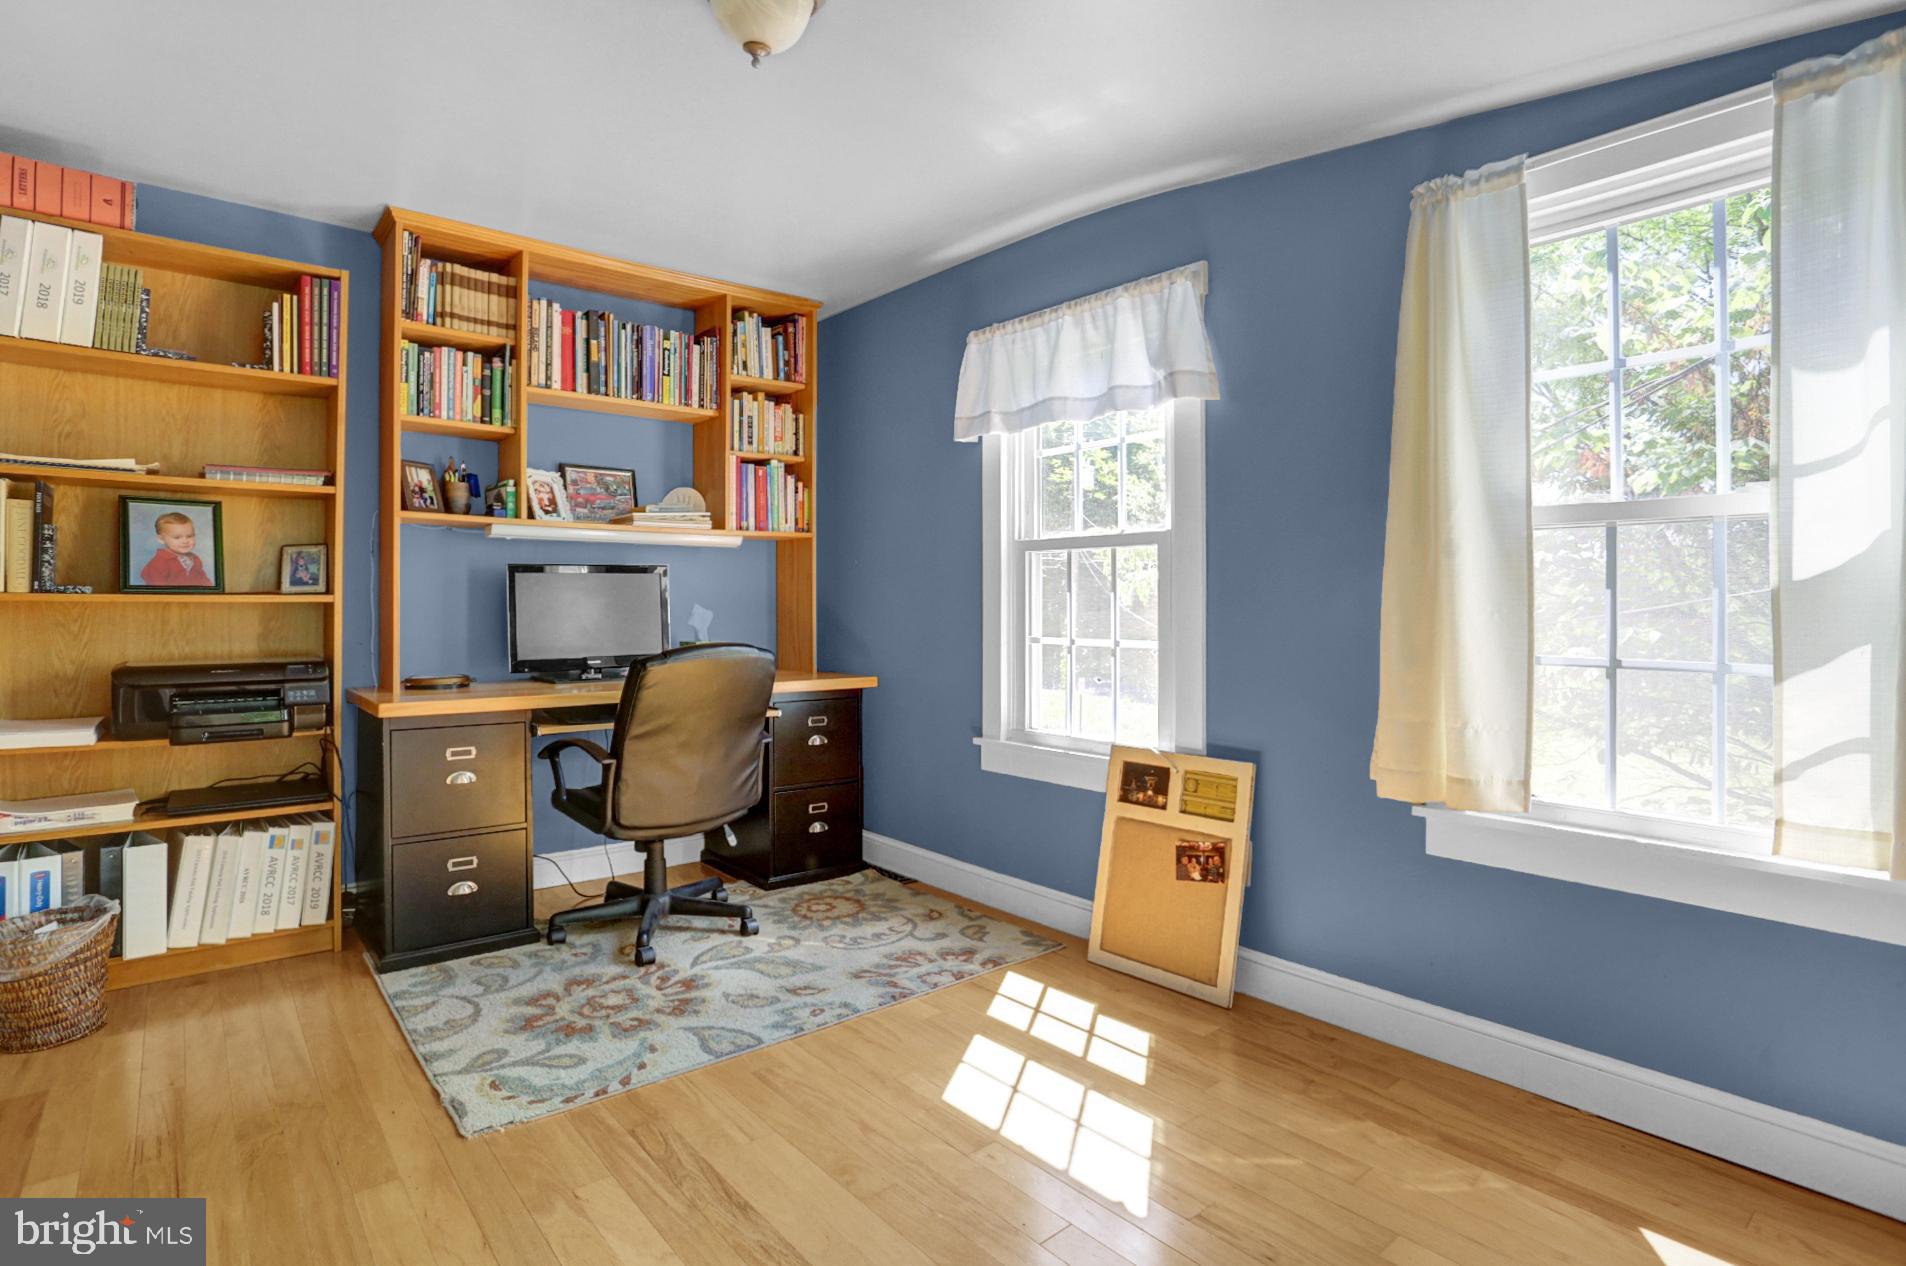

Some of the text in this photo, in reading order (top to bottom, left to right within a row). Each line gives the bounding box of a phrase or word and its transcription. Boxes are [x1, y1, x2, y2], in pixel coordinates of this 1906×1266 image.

[0, 272, 11, 296] 2017
[36, 282, 51, 309] 2018
[72, 280, 86, 305] 2019
[260, 856, 279, 917] AVRCC 2018
[287, 855, 300, 906] AVRCC 2017
[310, 851, 325, 910] AVRCC 2019
